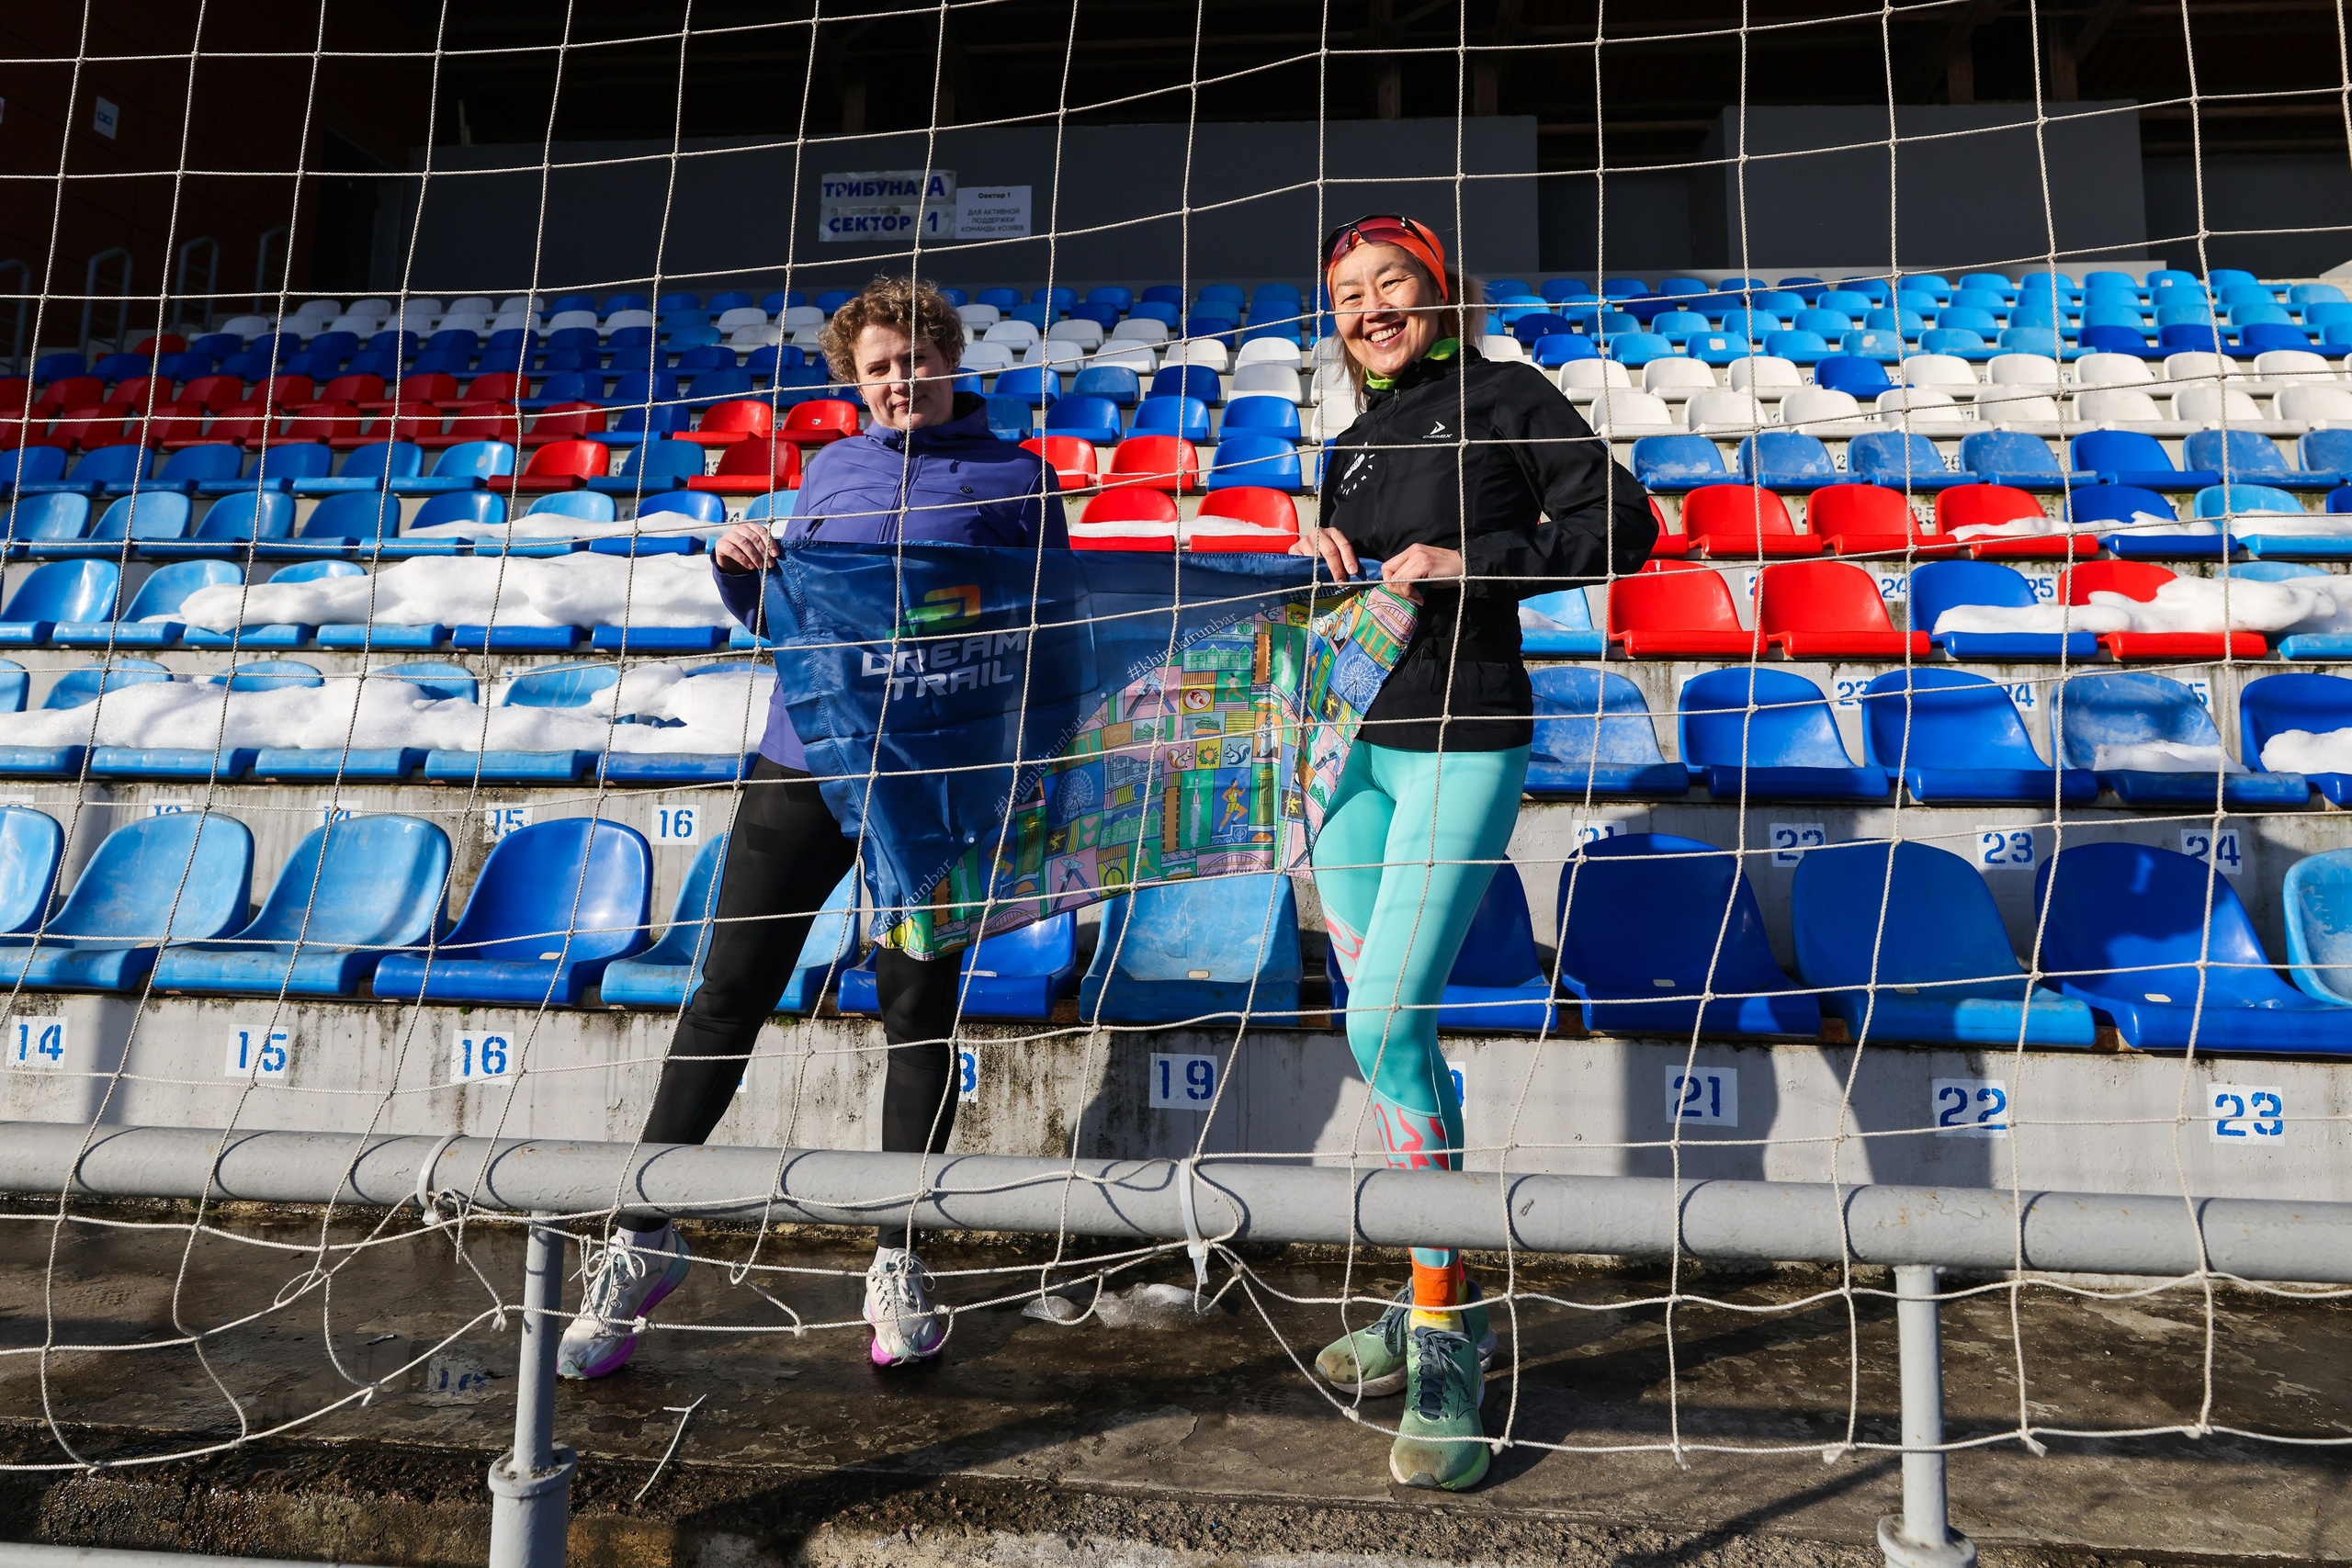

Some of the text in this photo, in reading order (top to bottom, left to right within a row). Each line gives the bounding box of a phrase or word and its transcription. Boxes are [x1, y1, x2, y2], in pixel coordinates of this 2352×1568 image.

[823, 180, 918, 197] ТРИБУНА
[829, 212, 938, 232] СЕКТОР 1
[861, 632, 1028, 677] DREAM
[884, 660, 1013, 701] TRAIL
[660, 809, 693, 838] 16
[1984, 832, 2033, 863] 23
[2187, 835, 2241, 866] 24
[18, 1024, 64, 1061] 14
[239, 1032, 288, 1072] 15
[462, 1036, 507, 1077] 16
[1159, 1060, 1214, 1100] 19
[1673, 1076, 1722, 1118] 21
[1939, 1087, 2007, 1130] 22
[2215, 1092, 2284, 1136] 23
